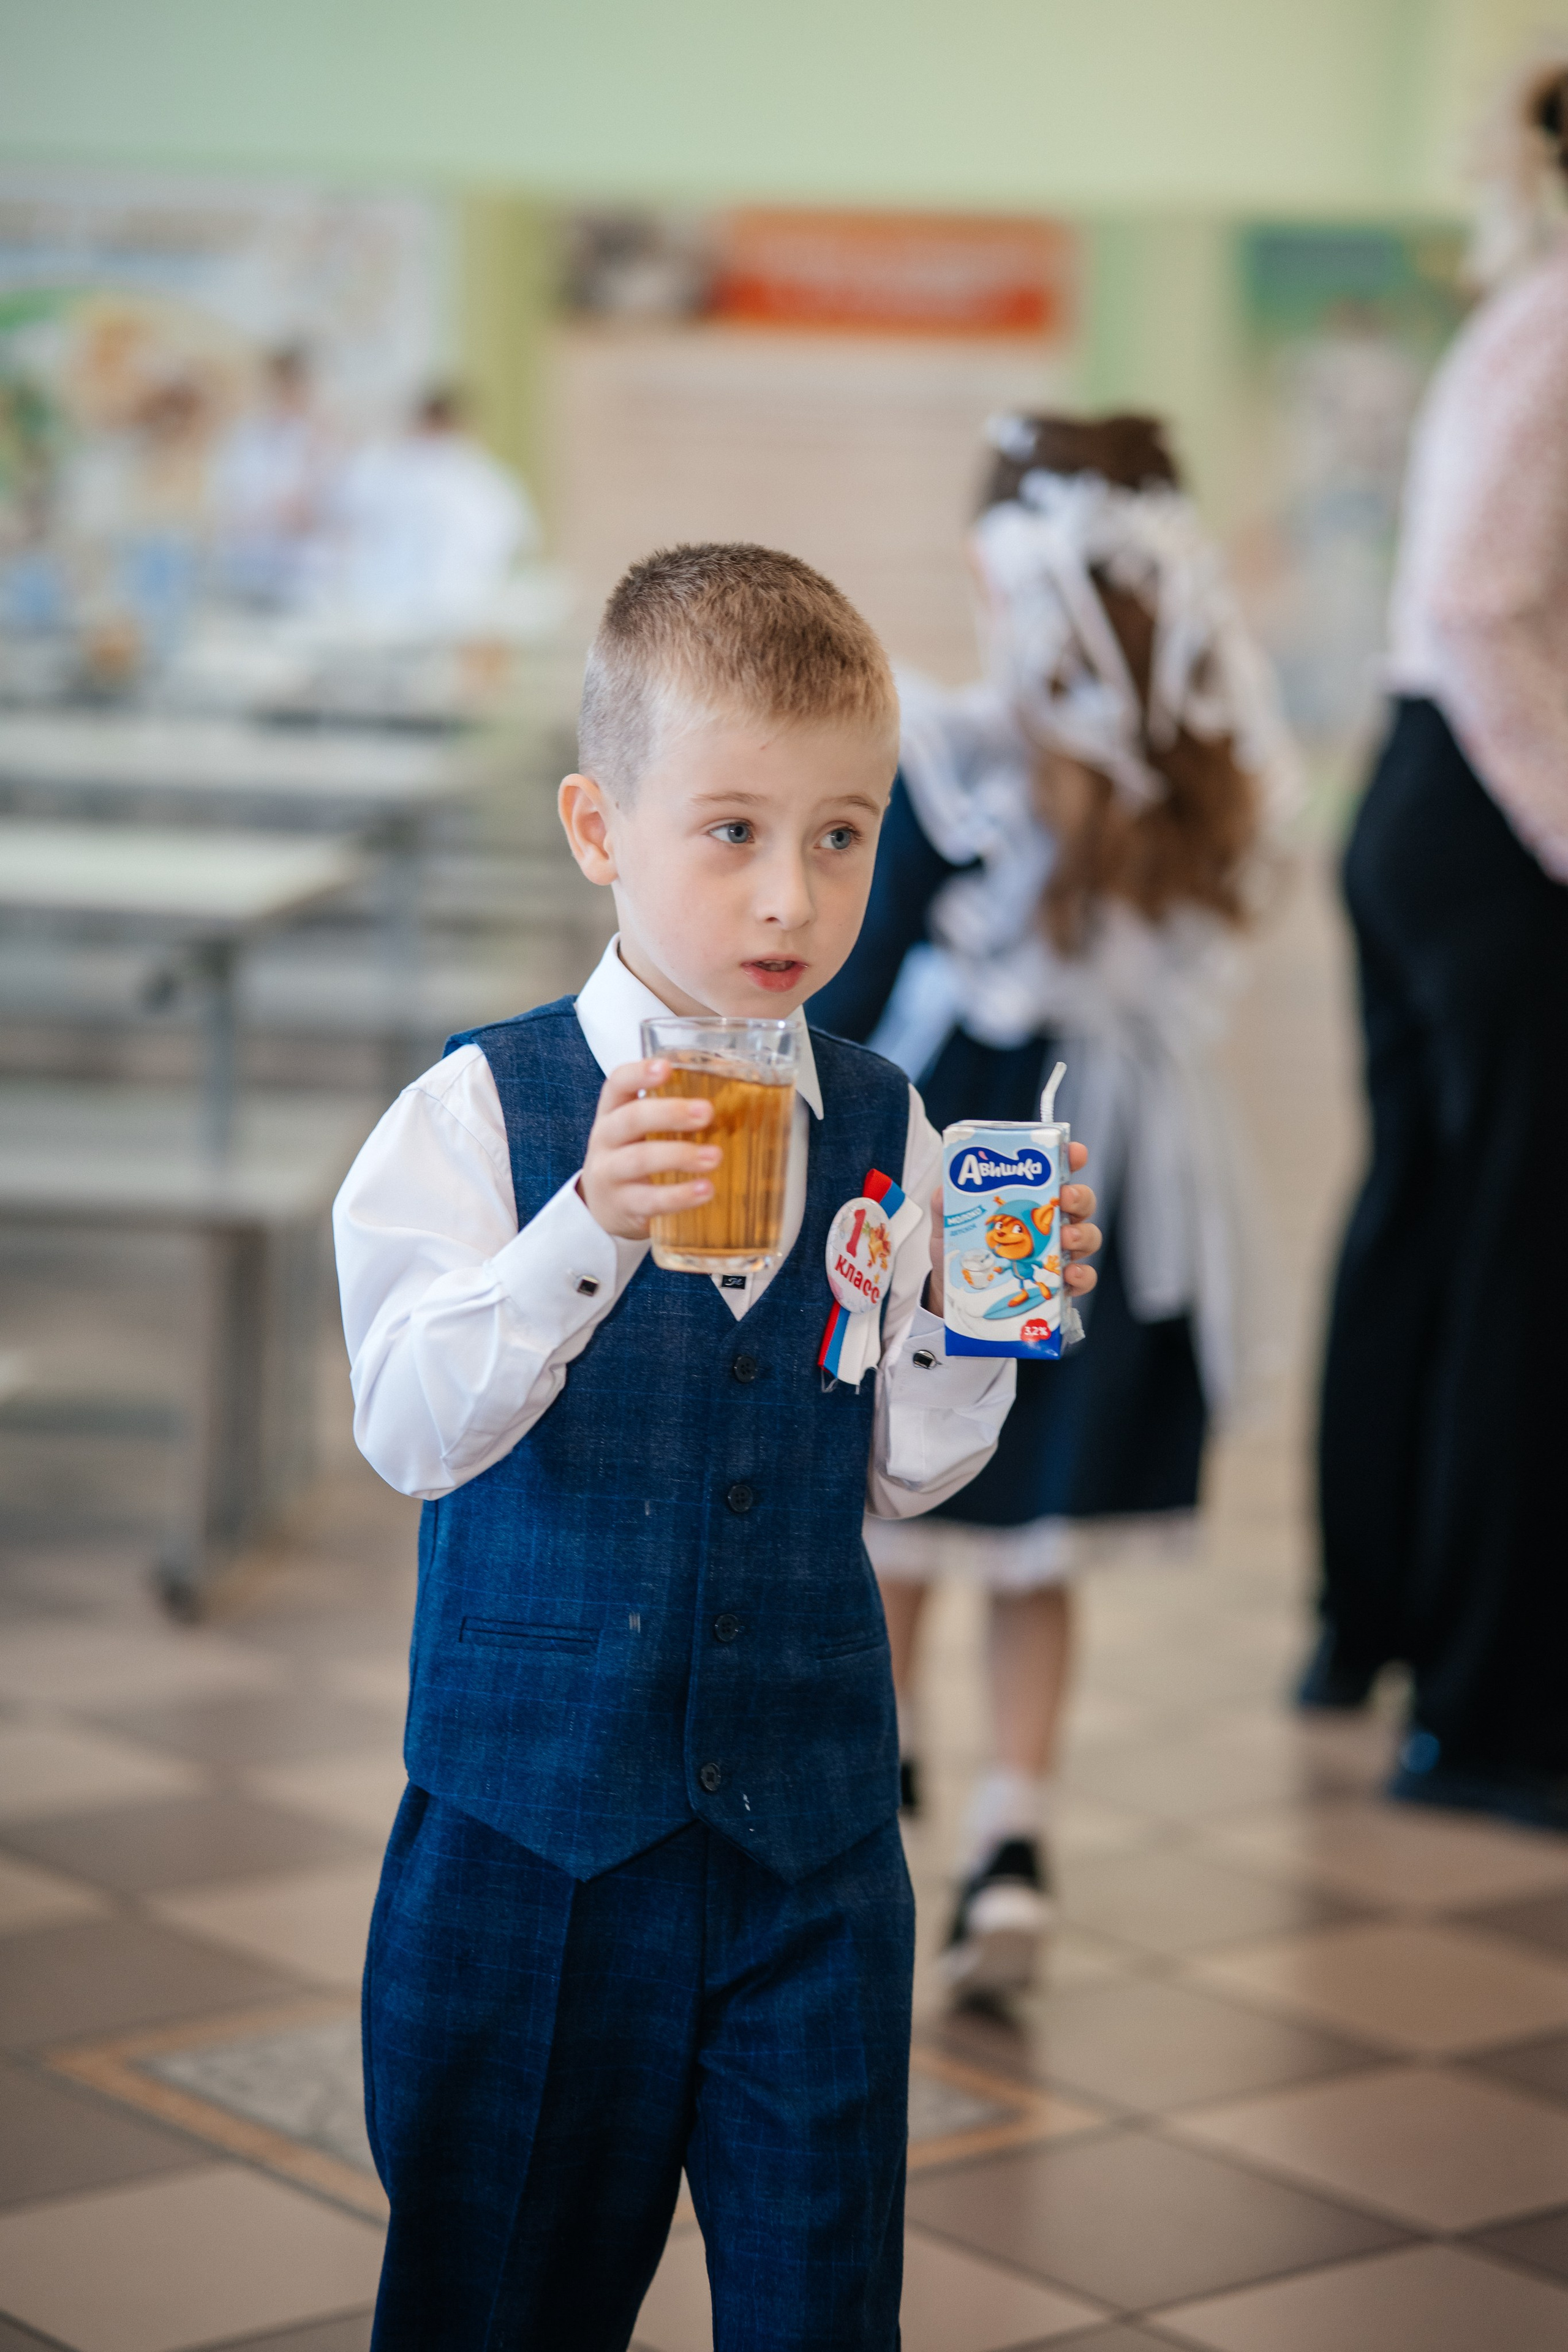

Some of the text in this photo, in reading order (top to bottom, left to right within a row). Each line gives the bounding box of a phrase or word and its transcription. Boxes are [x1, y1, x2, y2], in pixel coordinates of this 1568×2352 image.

[957, 1154, 1042, 1185] Авишка
[846, 1208, 866, 1258] 1
[835, 1254, 880, 1304] класс
